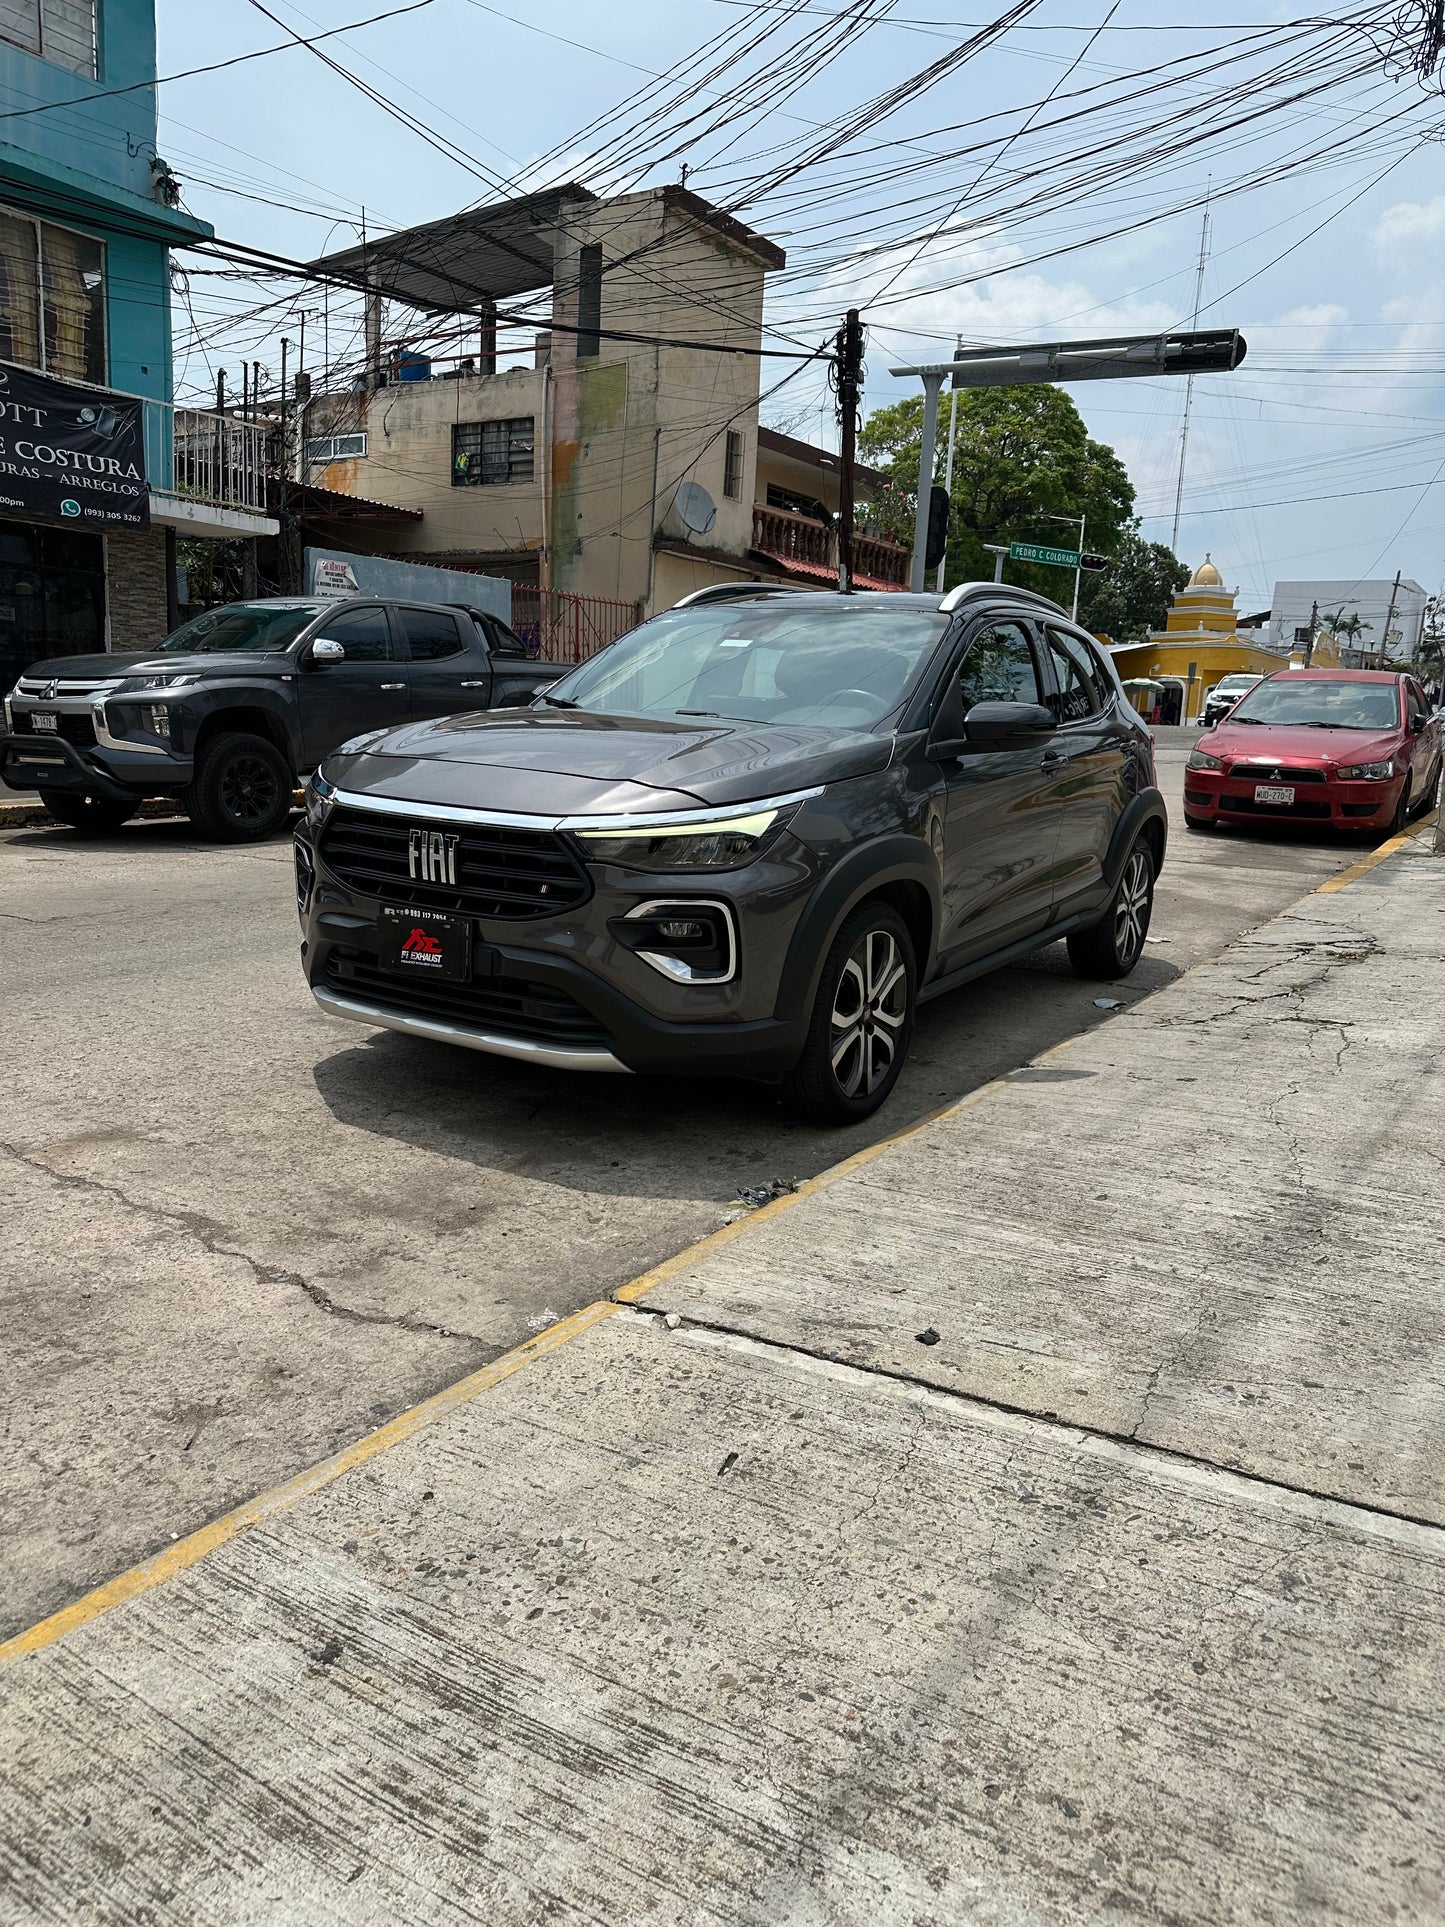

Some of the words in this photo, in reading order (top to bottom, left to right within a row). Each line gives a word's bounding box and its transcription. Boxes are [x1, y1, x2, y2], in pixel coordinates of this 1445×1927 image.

[14, 440, 141, 481] COSTURA
[59, 473, 140, 497] ARREGLOS
[84, 508, 105, 518] (993)
[106, 512, 122, 520] 305
[123, 514, 142, 522] 3262
[1015, 547, 1037, 558] PEDRO
[1045, 551, 1078, 565] COLORADO
[408, 828, 460, 885] FIAT
[410, 951, 443, 963] EXHAUST
